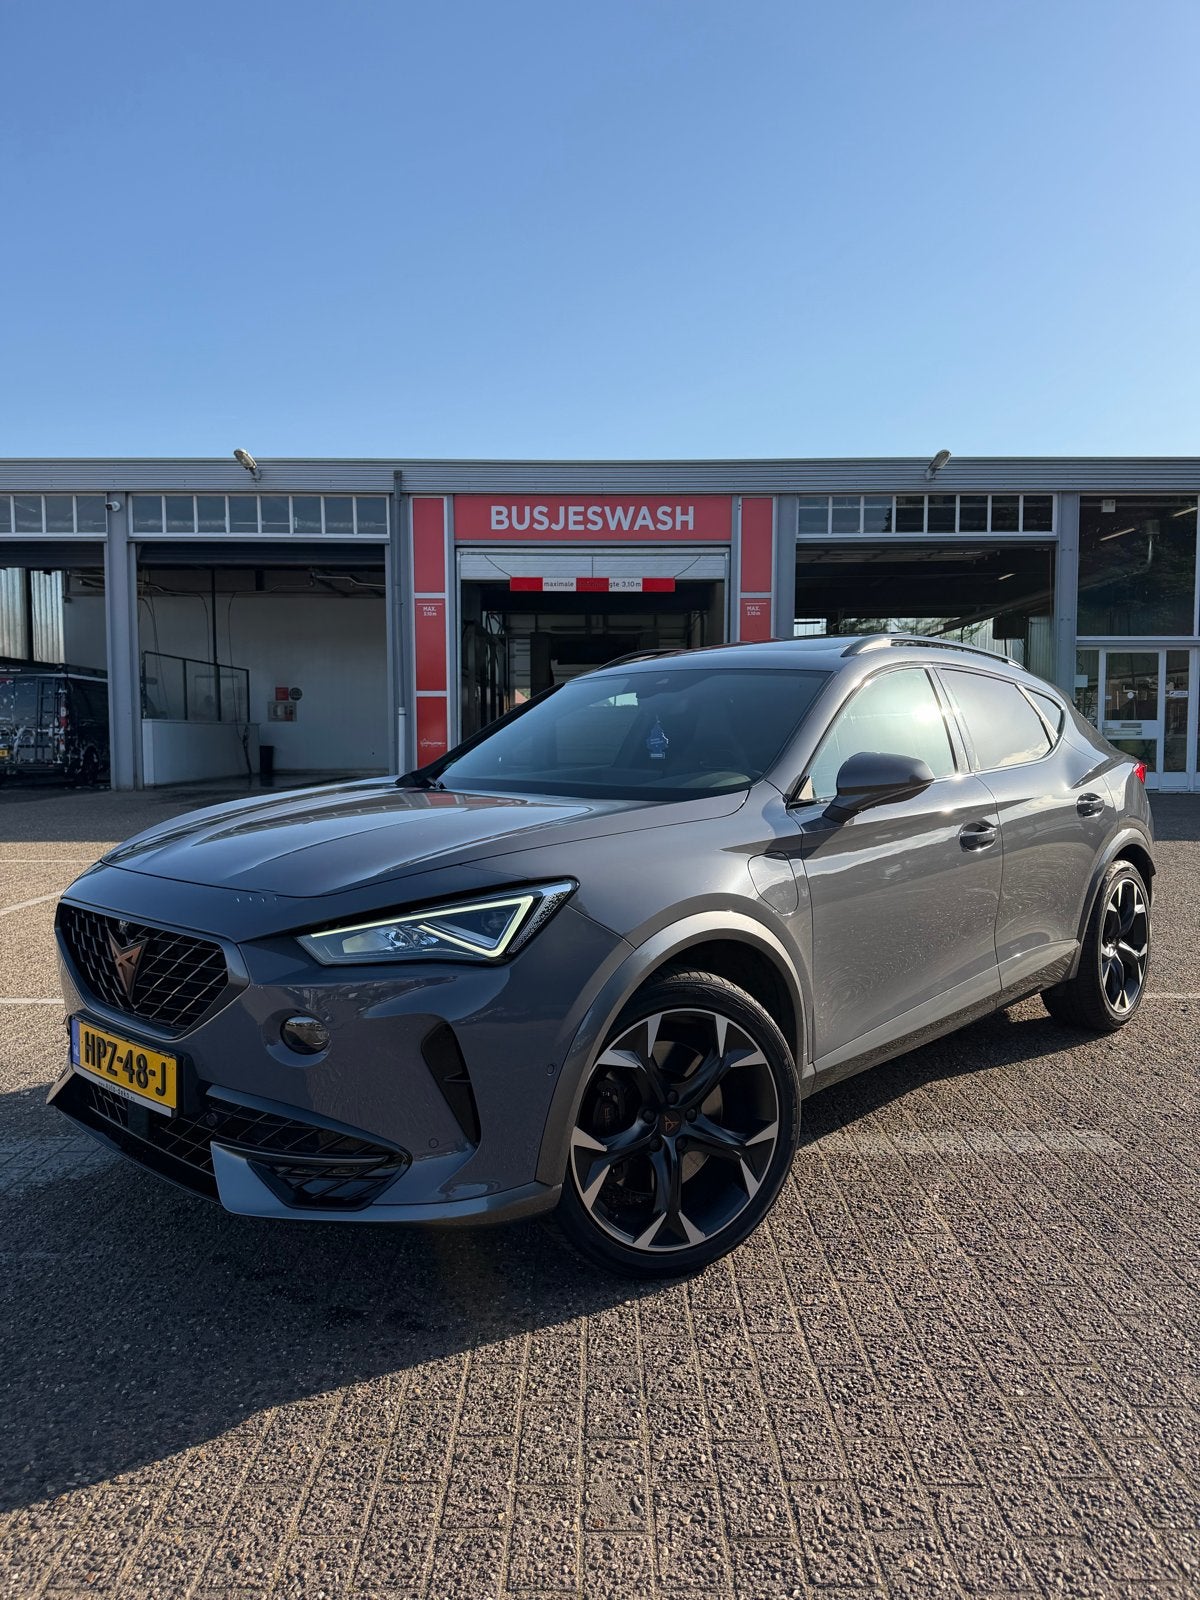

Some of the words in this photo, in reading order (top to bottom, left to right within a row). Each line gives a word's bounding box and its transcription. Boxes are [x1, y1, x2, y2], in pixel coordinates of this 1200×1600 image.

[490, 505, 695, 531] BUSJESWASH
[543, 580, 574, 588] maximale
[84, 1031, 167, 1097] HPZ-48-J
